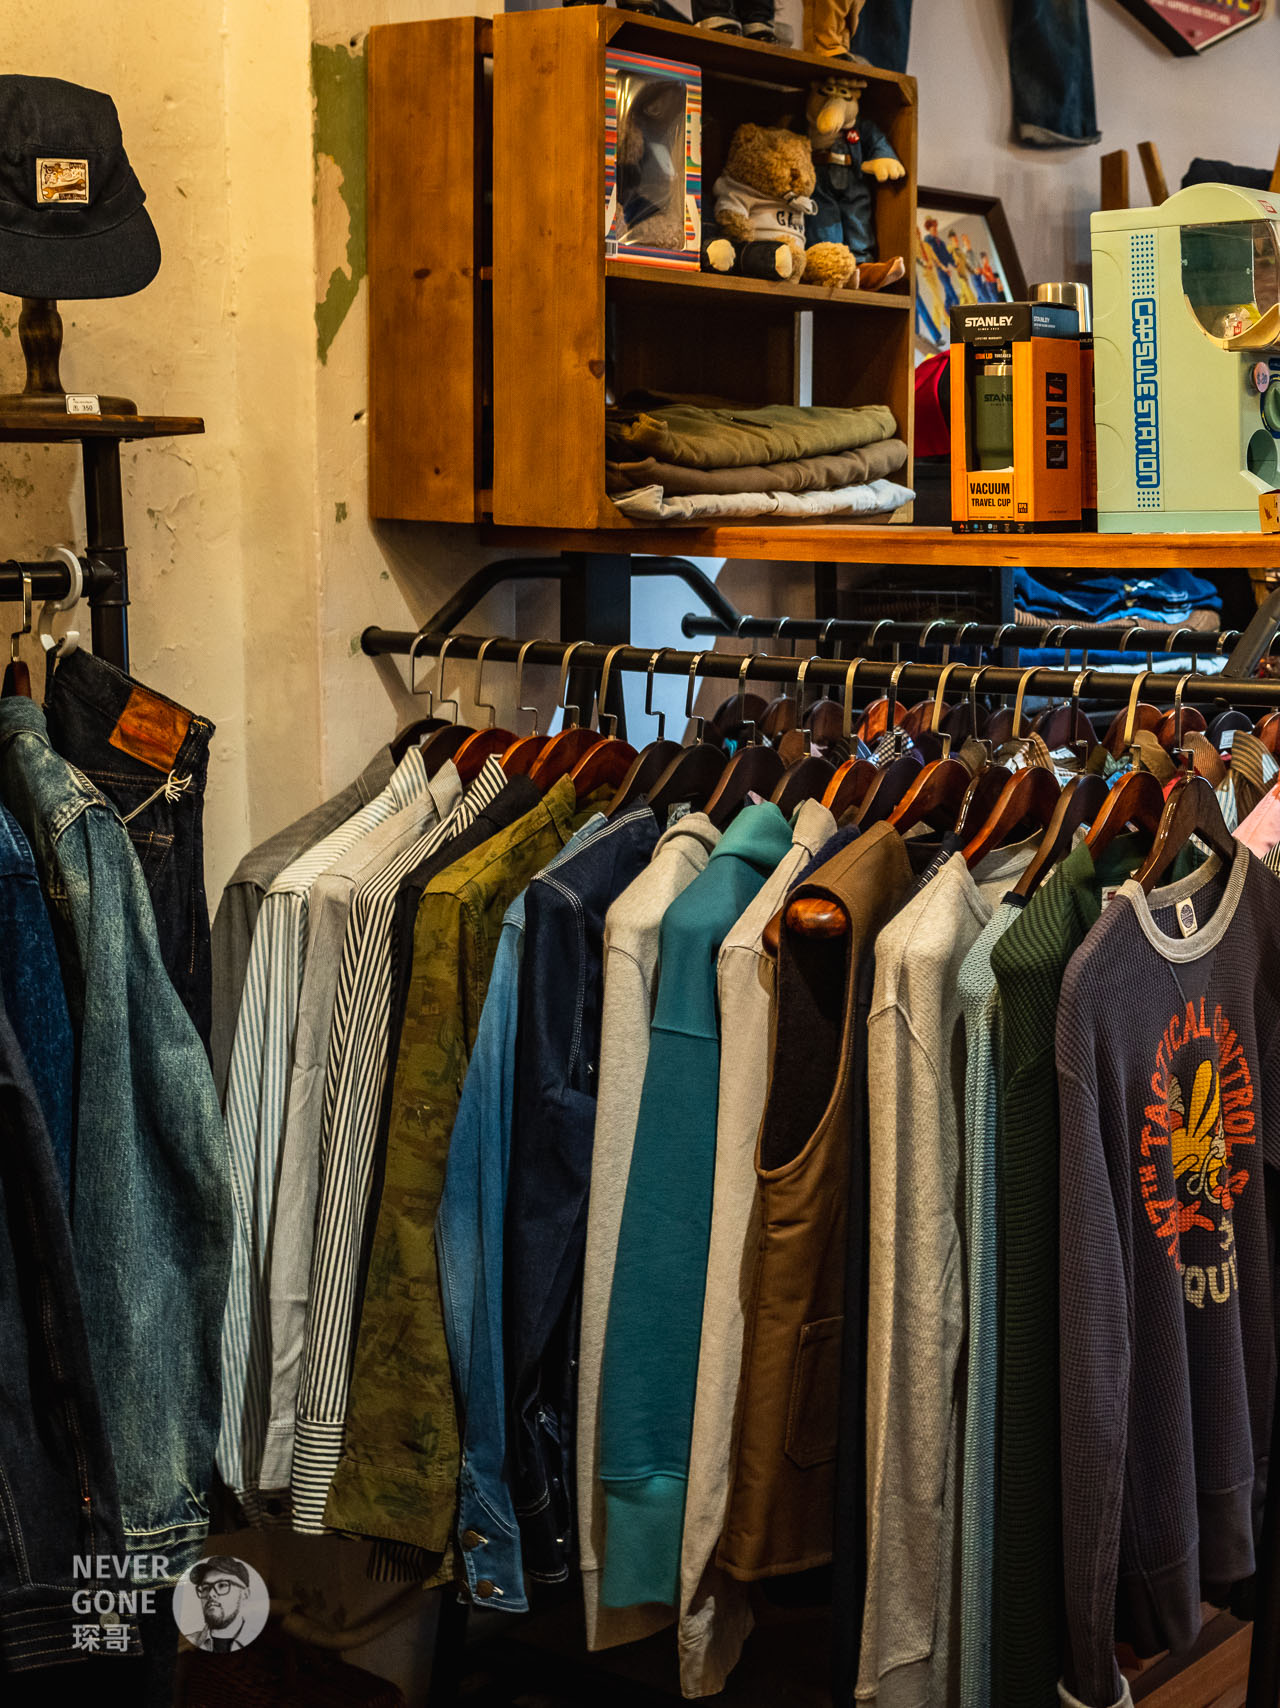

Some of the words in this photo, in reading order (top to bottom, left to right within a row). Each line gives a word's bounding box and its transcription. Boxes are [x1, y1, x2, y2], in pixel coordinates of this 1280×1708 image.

[964, 316, 1013, 328] STANLEY
[1132, 298, 1158, 398] CAPSULE
[984, 394, 1013, 402] STANL
[1134, 398, 1160, 488] STATION
[970, 482, 1010, 494] VACUUM
[971, 498, 996, 507] TRAVEL
[997, 498, 1011, 507] CUP
[1140, 996, 1211, 1157] TACTICAL
